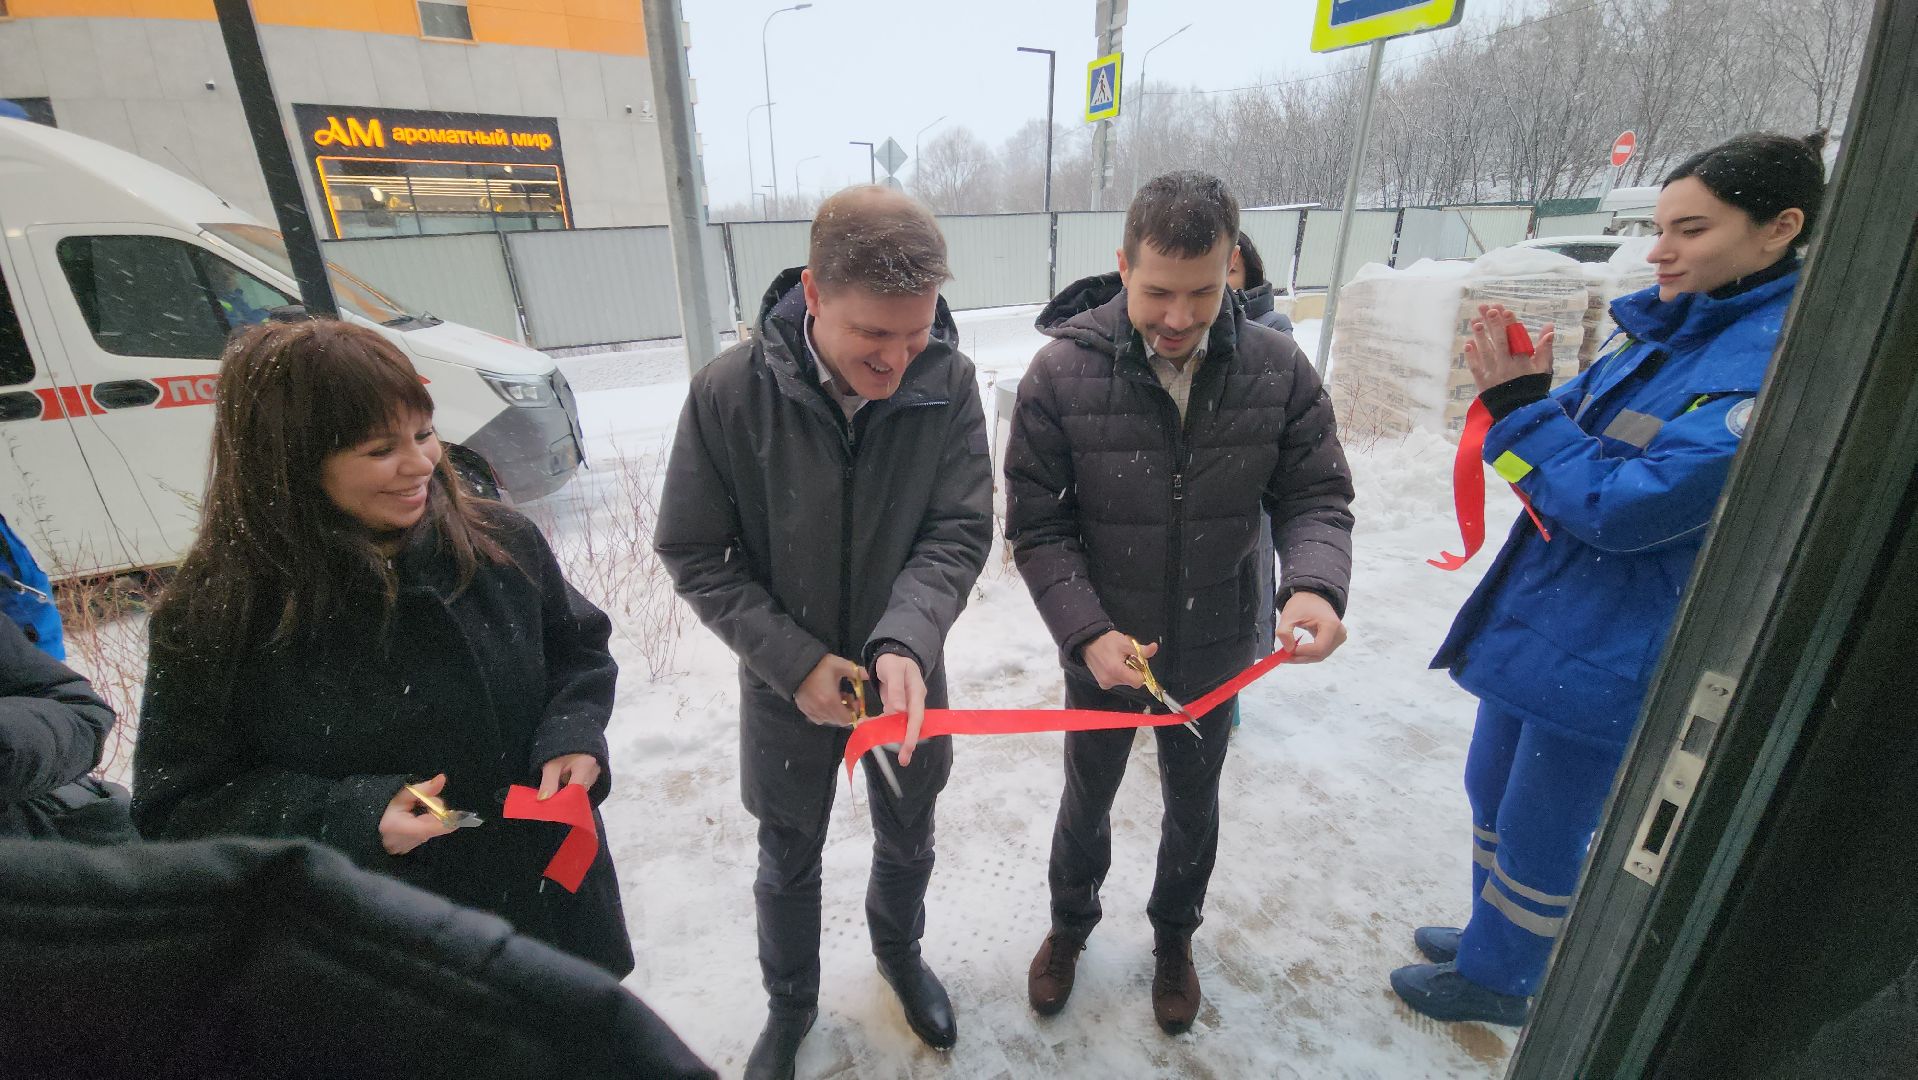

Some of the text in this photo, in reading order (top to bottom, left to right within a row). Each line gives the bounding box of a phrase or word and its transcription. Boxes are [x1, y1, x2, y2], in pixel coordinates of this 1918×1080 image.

[313, 116, 552, 150] АМ ароматный мир
